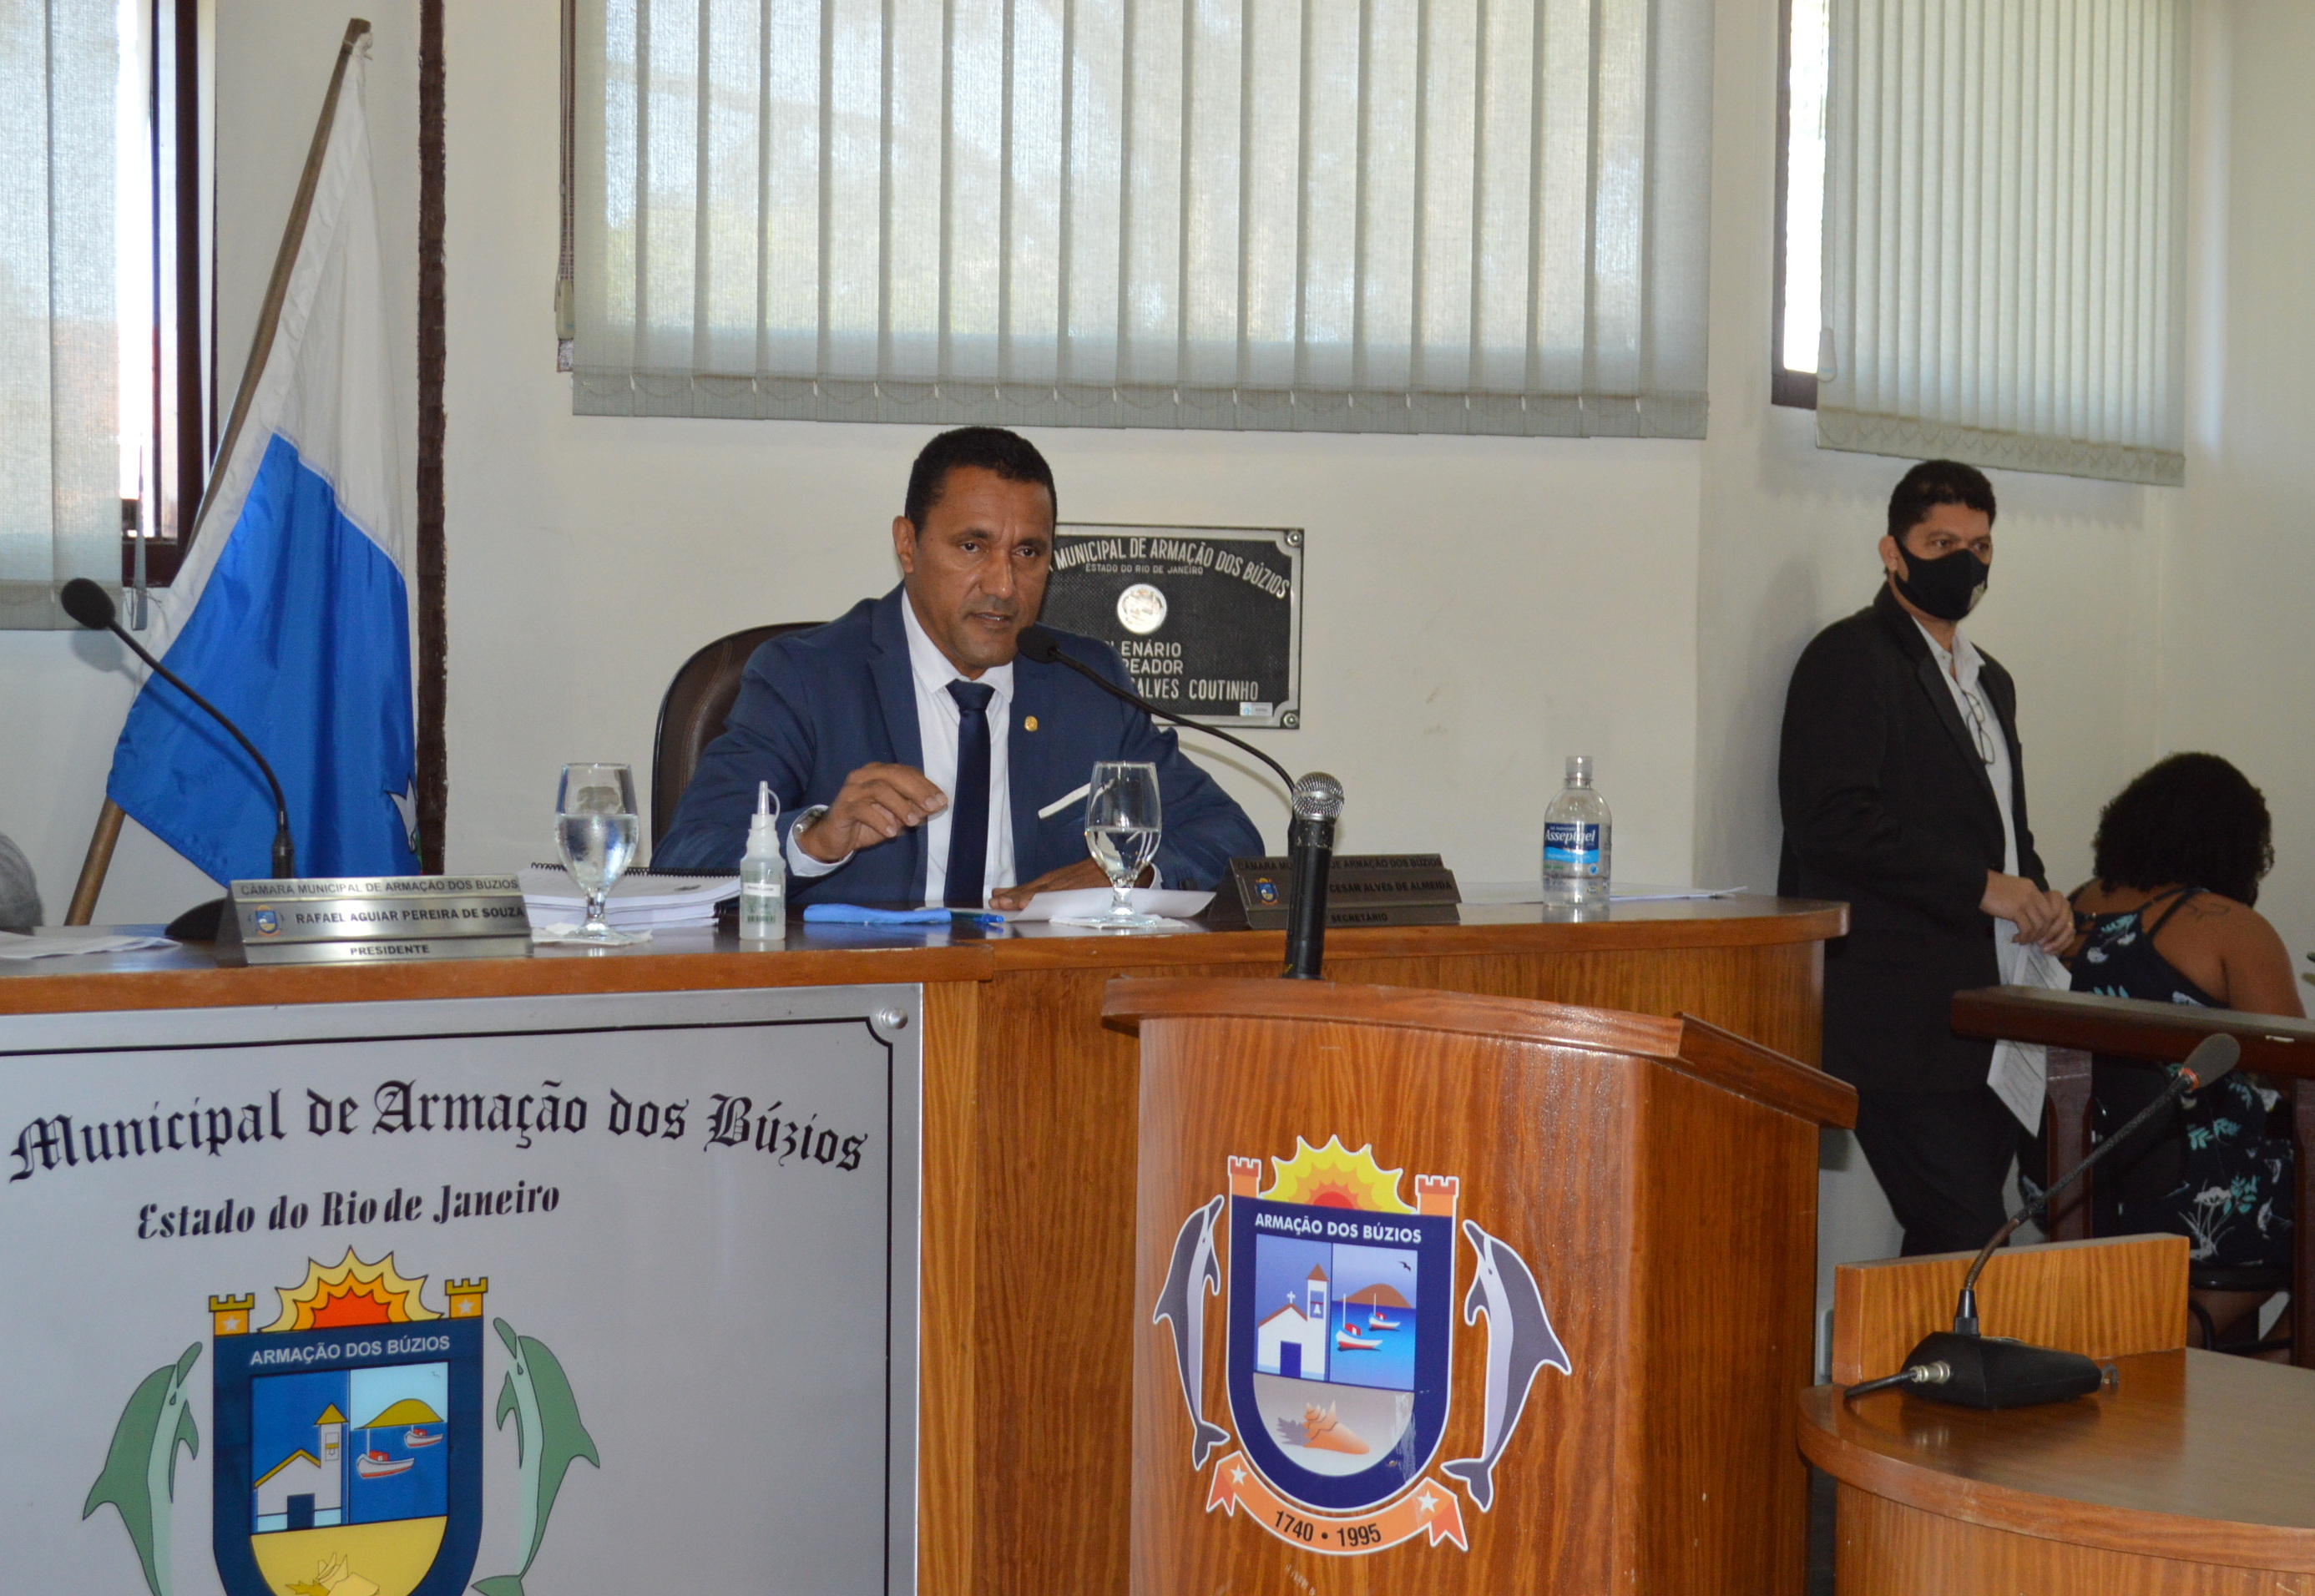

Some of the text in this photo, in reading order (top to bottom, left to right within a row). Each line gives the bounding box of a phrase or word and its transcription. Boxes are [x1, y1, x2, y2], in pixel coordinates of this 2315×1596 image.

[1054, 537, 1290, 598] MUNICIPAL DE ARMAÇÃO DOS BÚZIOS
[1085, 563, 1204, 575] ESTADO DO RIO DE JANEIRO
[1130, 677, 1259, 701] ALVES COUTINHO
[297, 882, 362, 894] MUNICIPAL
[365, 881, 383, 893] DE
[386, 879, 445, 893] ARMAÇÃO
[447, 879, 473, 891] DOS
[476, 877, 519, 890] BÚZIOS
[1364, 882, 1393, 892] ALVES
[1395, 881, 1408, 891] DE
[1411, 880, 1453, 891] ALMEIDA
[296, 906, 524, 924] RAFAEL AGUIAR PEREIRA DE SOUZA
[350, 944, 431, 957] PRESIDENTE
[10, 1078, 869, 1183] Municipal de Armação dos Búzios
[138, 1179, 560, 1240] Estado do Rio de Janeiro
[1254, 1213, 1423, 1244] ARMAÇÃO DOS BÚZIOS
[250, 1335, 451, 1366] ARMAÇÃO DOS BÚZIOS
[1274, 1510, 1382, 1547] 1740 1995
